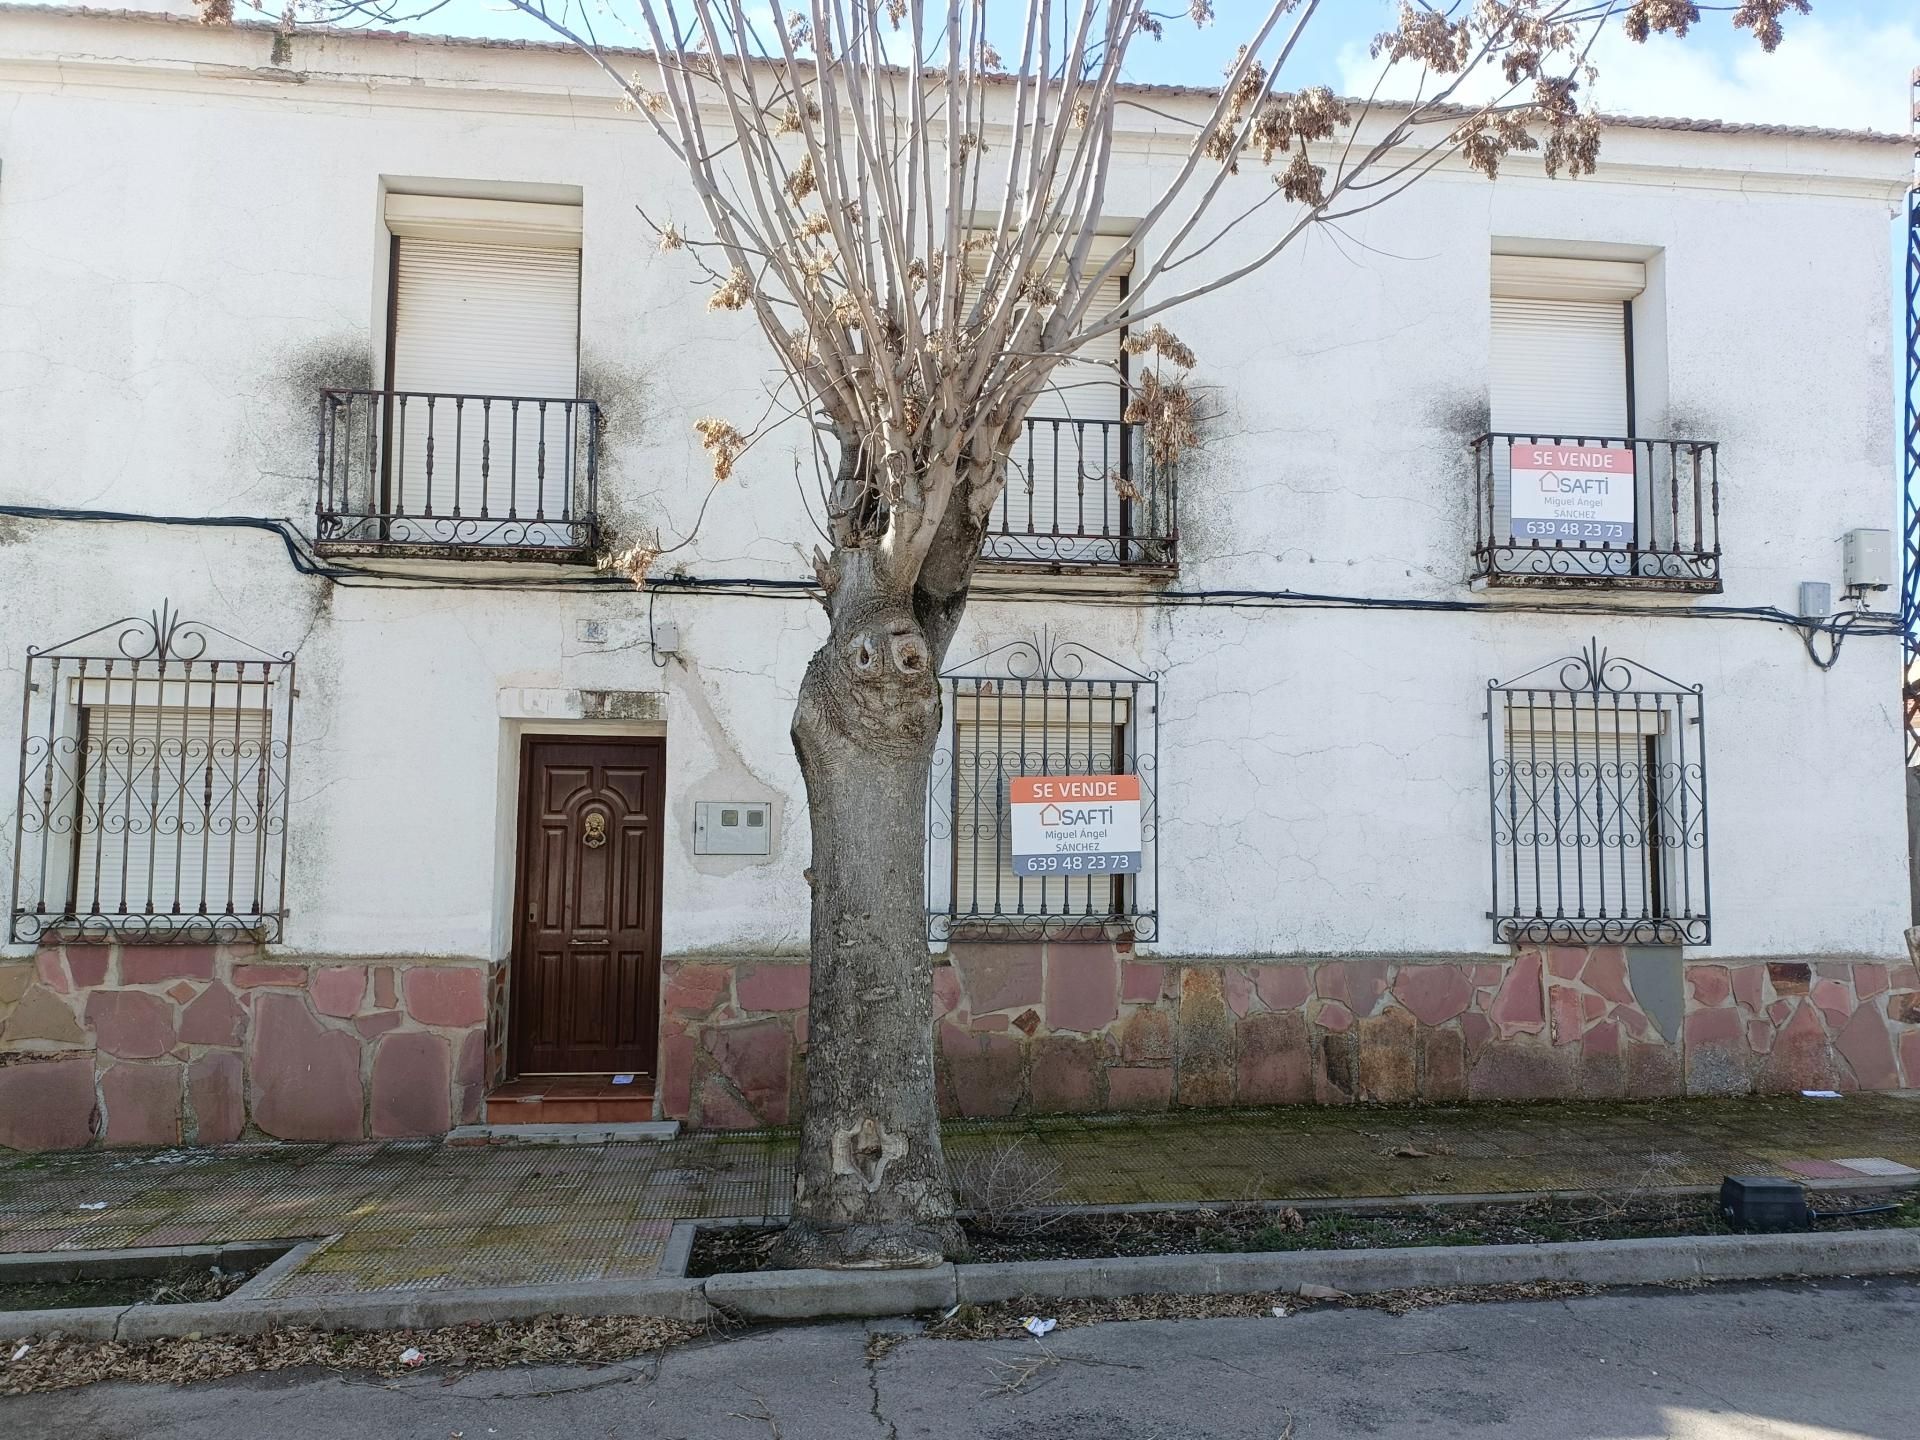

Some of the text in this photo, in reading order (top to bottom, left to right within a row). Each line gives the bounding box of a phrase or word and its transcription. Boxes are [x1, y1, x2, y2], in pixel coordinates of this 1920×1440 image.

[1533, 451, 1613, 468] SE VENDE
[1544, 496, 1575, 507] Miguel
[1526, 521, 1623, 538] 639 48 23 73
[1032, 781, 1118, 798] SE VENDE
[1045, 828, 1107, 841] Miguel Ángel
[1055, 841, 1101, 853] SÁNCHEZ
[1027, 855, 1129, 871] 639 48 23 73
